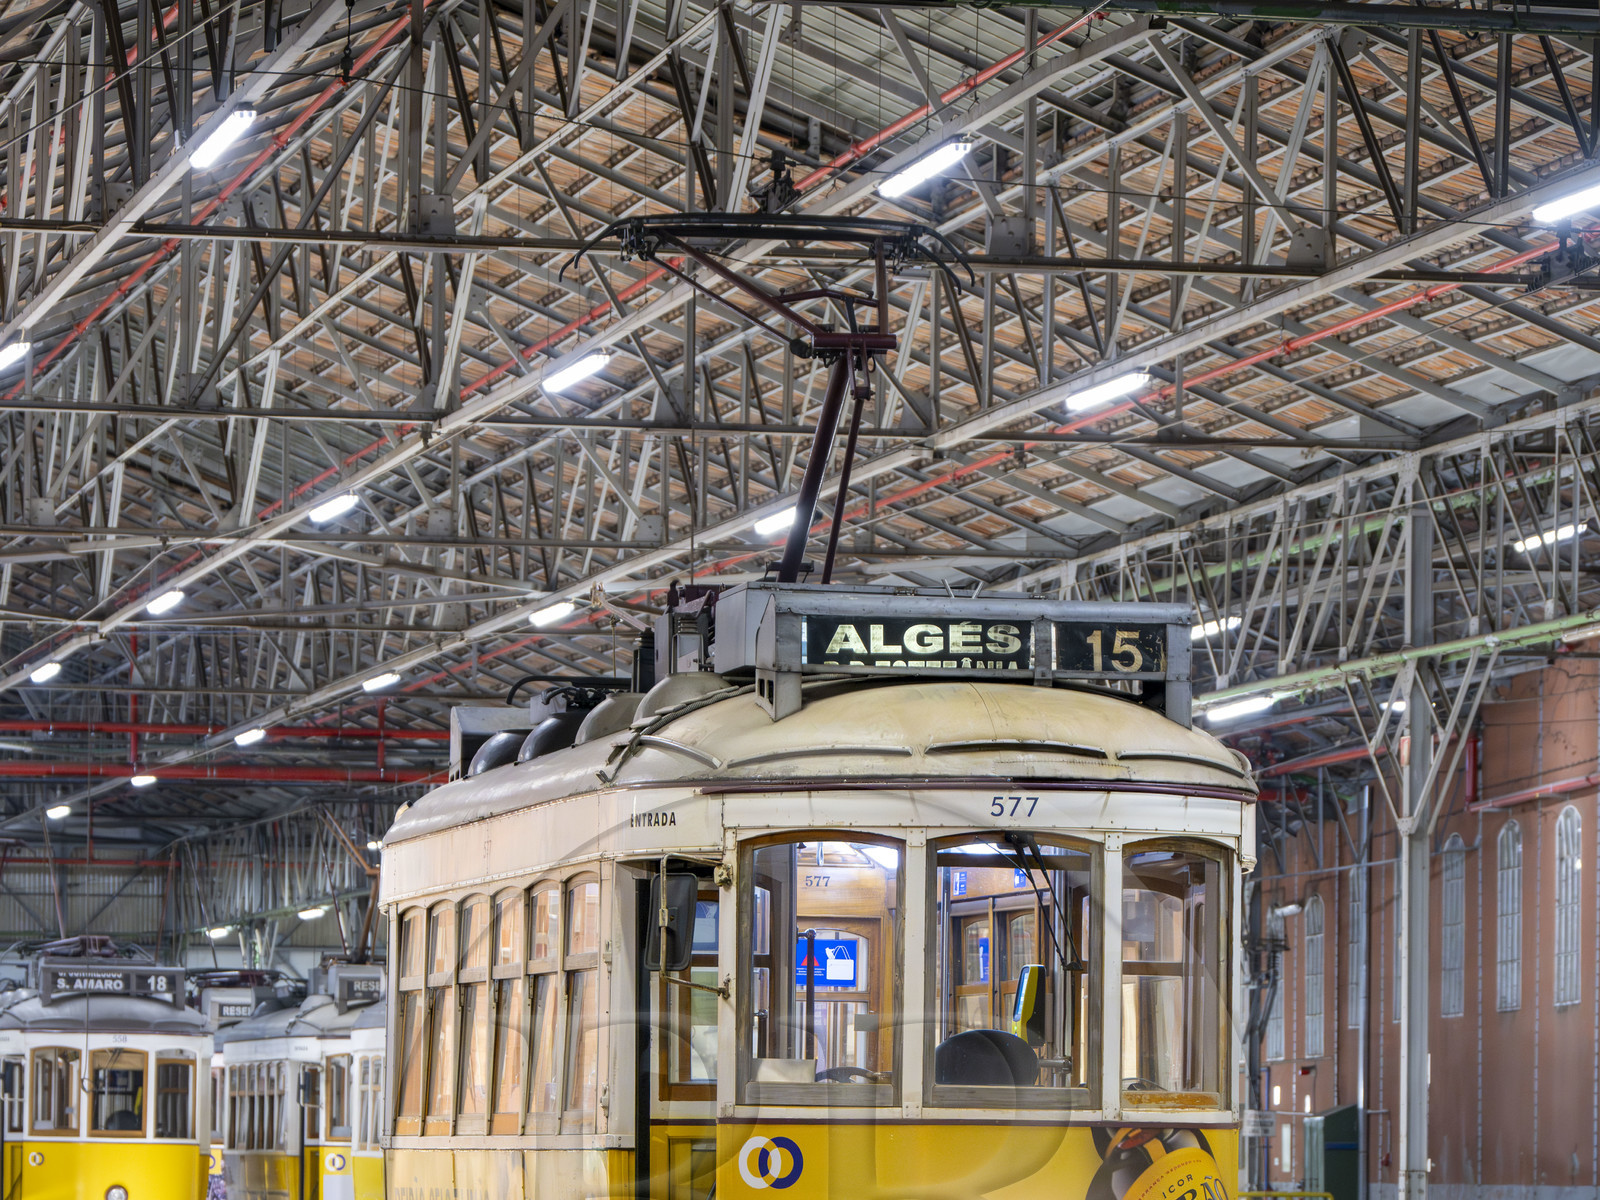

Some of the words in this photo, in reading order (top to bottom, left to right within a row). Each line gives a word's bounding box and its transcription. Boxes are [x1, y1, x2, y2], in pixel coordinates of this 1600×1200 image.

[825, 621, 1022, 654] ALGÉS
[1086, 629, 1144, 673] 15
[990, 796, 1039, 817] 577
[630, 812, 676, 828] ENTRADA
[805, 875, 830, 887] 577
[56, 978, 69, 990] S.
[73, 978, 124, 991] AMARO
[147, 975, 167, 991] 18
